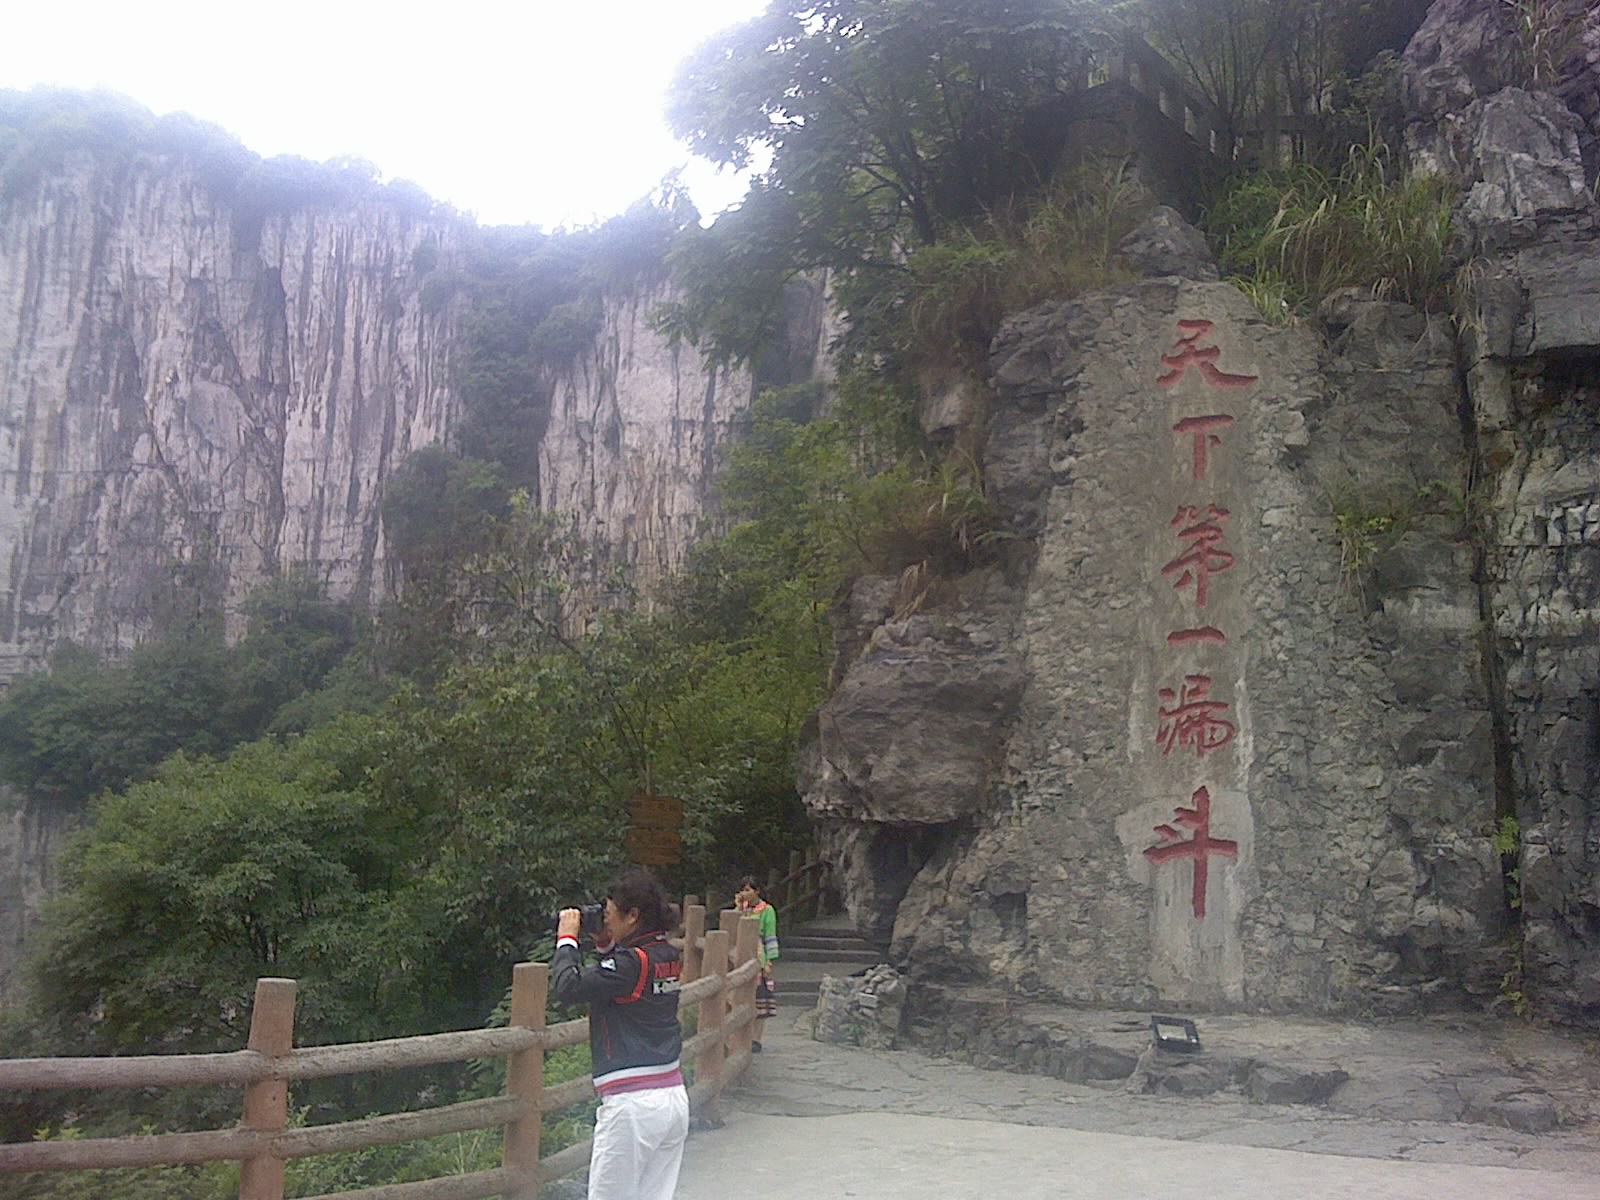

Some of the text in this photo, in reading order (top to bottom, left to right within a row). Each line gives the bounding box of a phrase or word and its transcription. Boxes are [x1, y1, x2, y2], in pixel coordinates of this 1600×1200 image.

[1143, 319, 1258, 919] 天下第一漏斗
